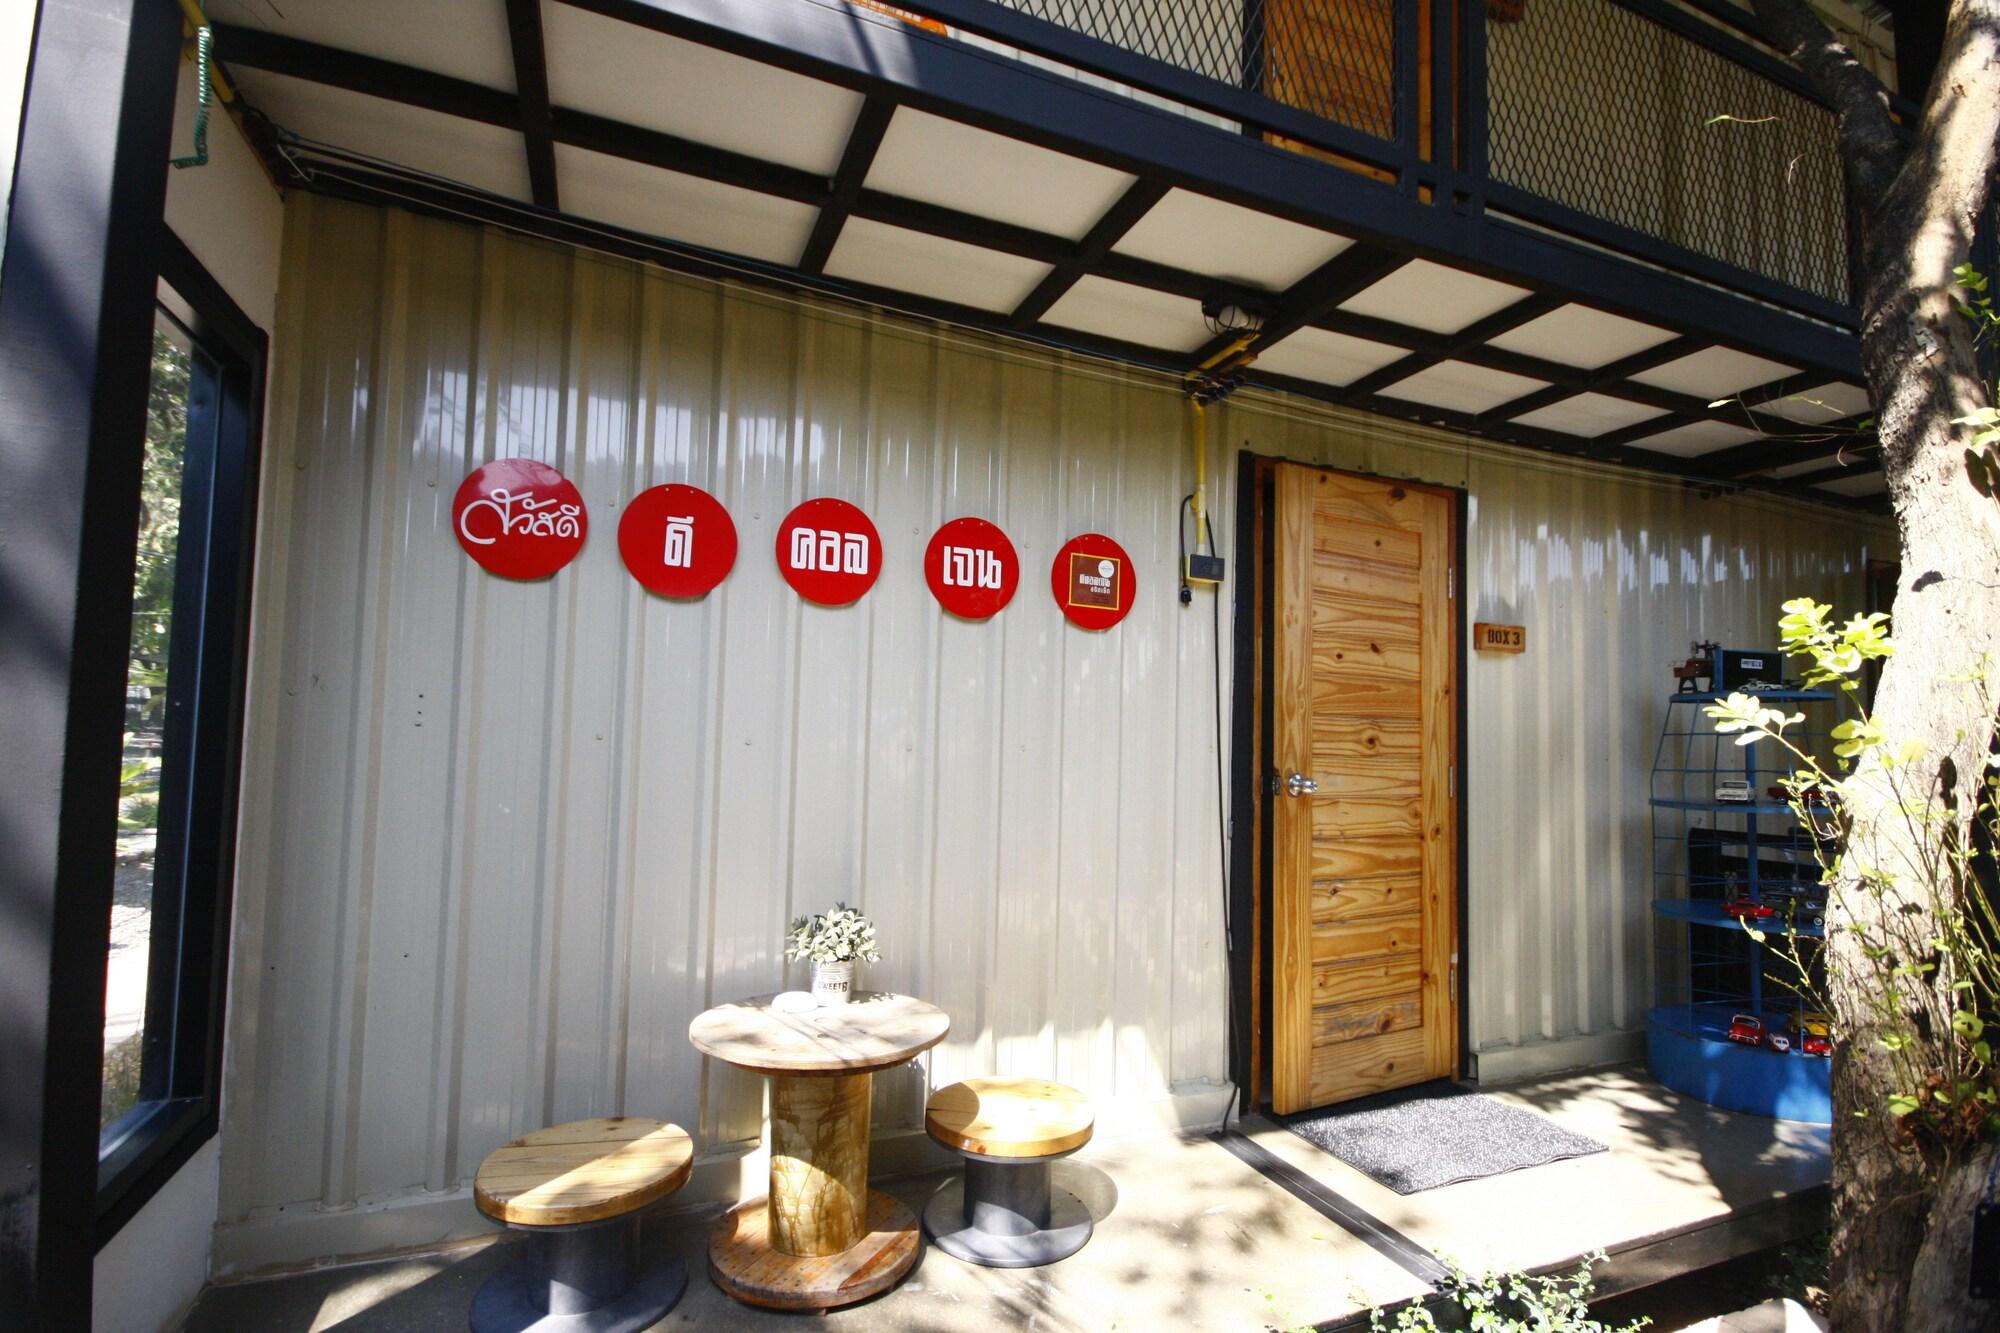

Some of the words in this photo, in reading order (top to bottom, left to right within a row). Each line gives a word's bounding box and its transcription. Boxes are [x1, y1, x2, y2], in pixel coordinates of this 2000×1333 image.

[461, 488, 580, 544] สวัสดี
[664, 516, 694, 568] ดี
[1488, 629, 1510, 645] BOX
[1513, 632, 1521, 645] 3
